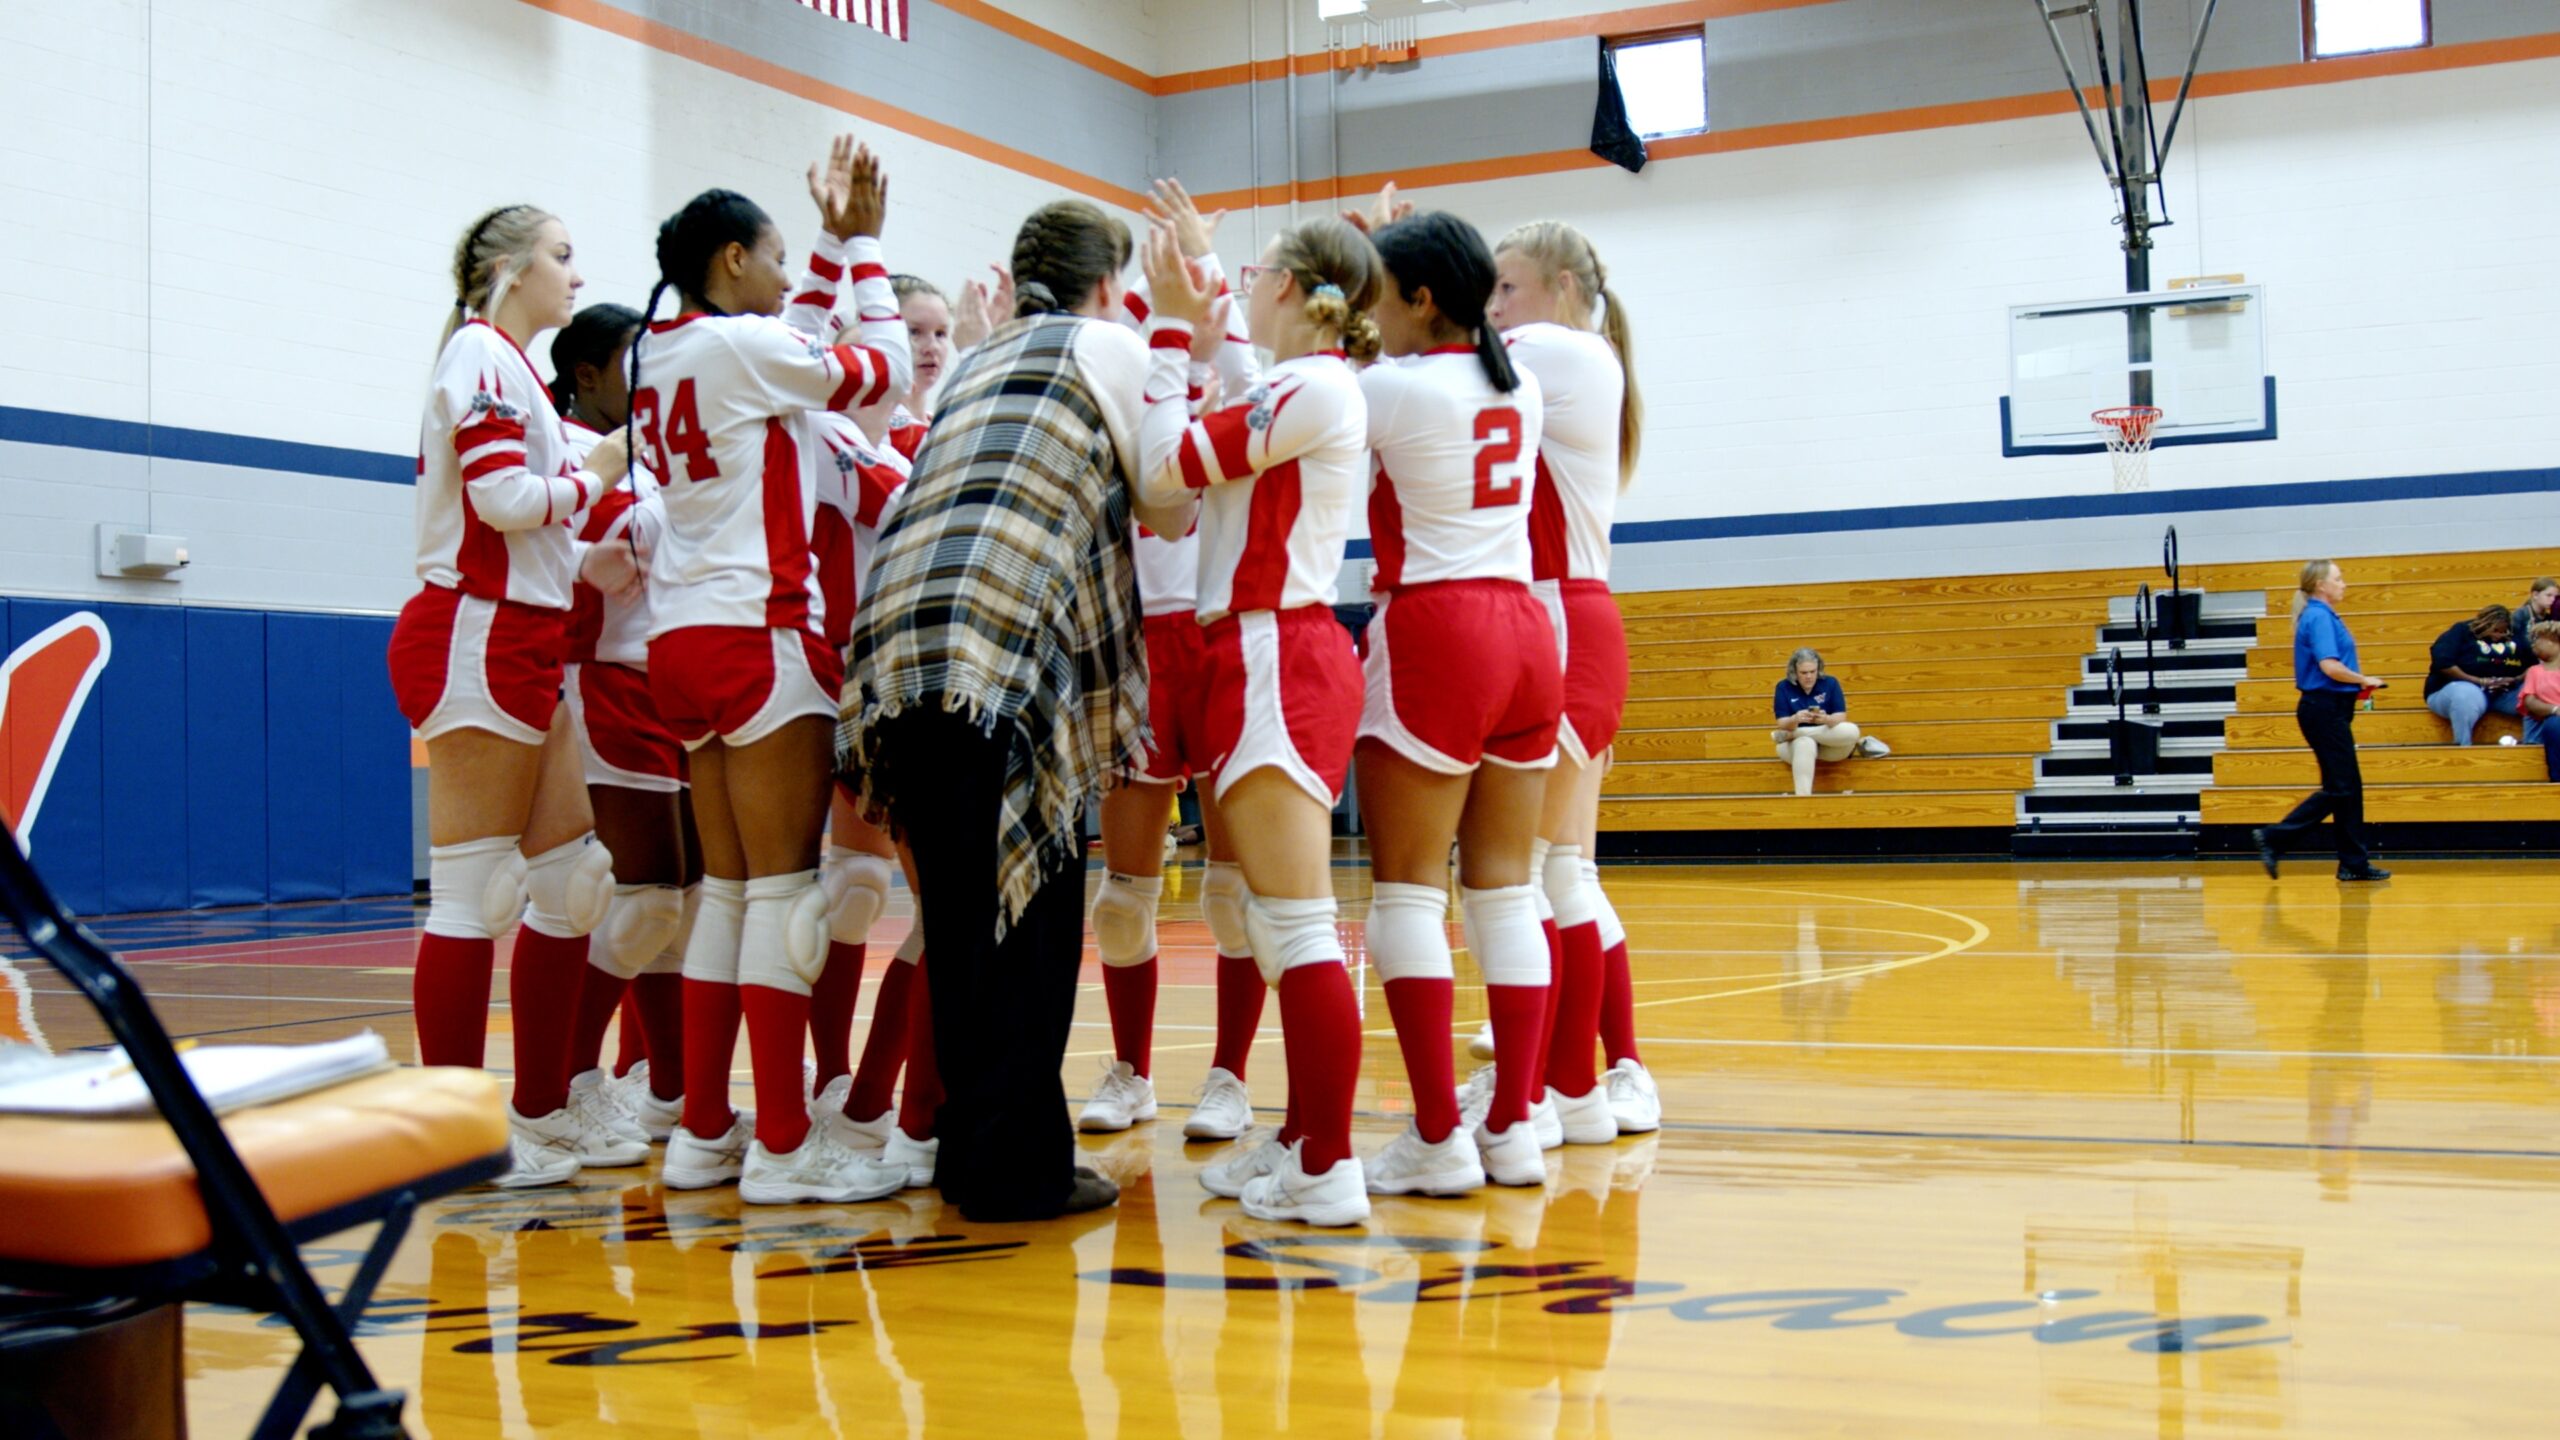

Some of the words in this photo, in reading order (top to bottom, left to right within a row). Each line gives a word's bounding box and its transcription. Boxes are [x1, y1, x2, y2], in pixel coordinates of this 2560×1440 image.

[633, 377, 721, 487] 34
[1471, 405, 1523, 510] 2
[1074, 1235, 2292, 1354] Strain
